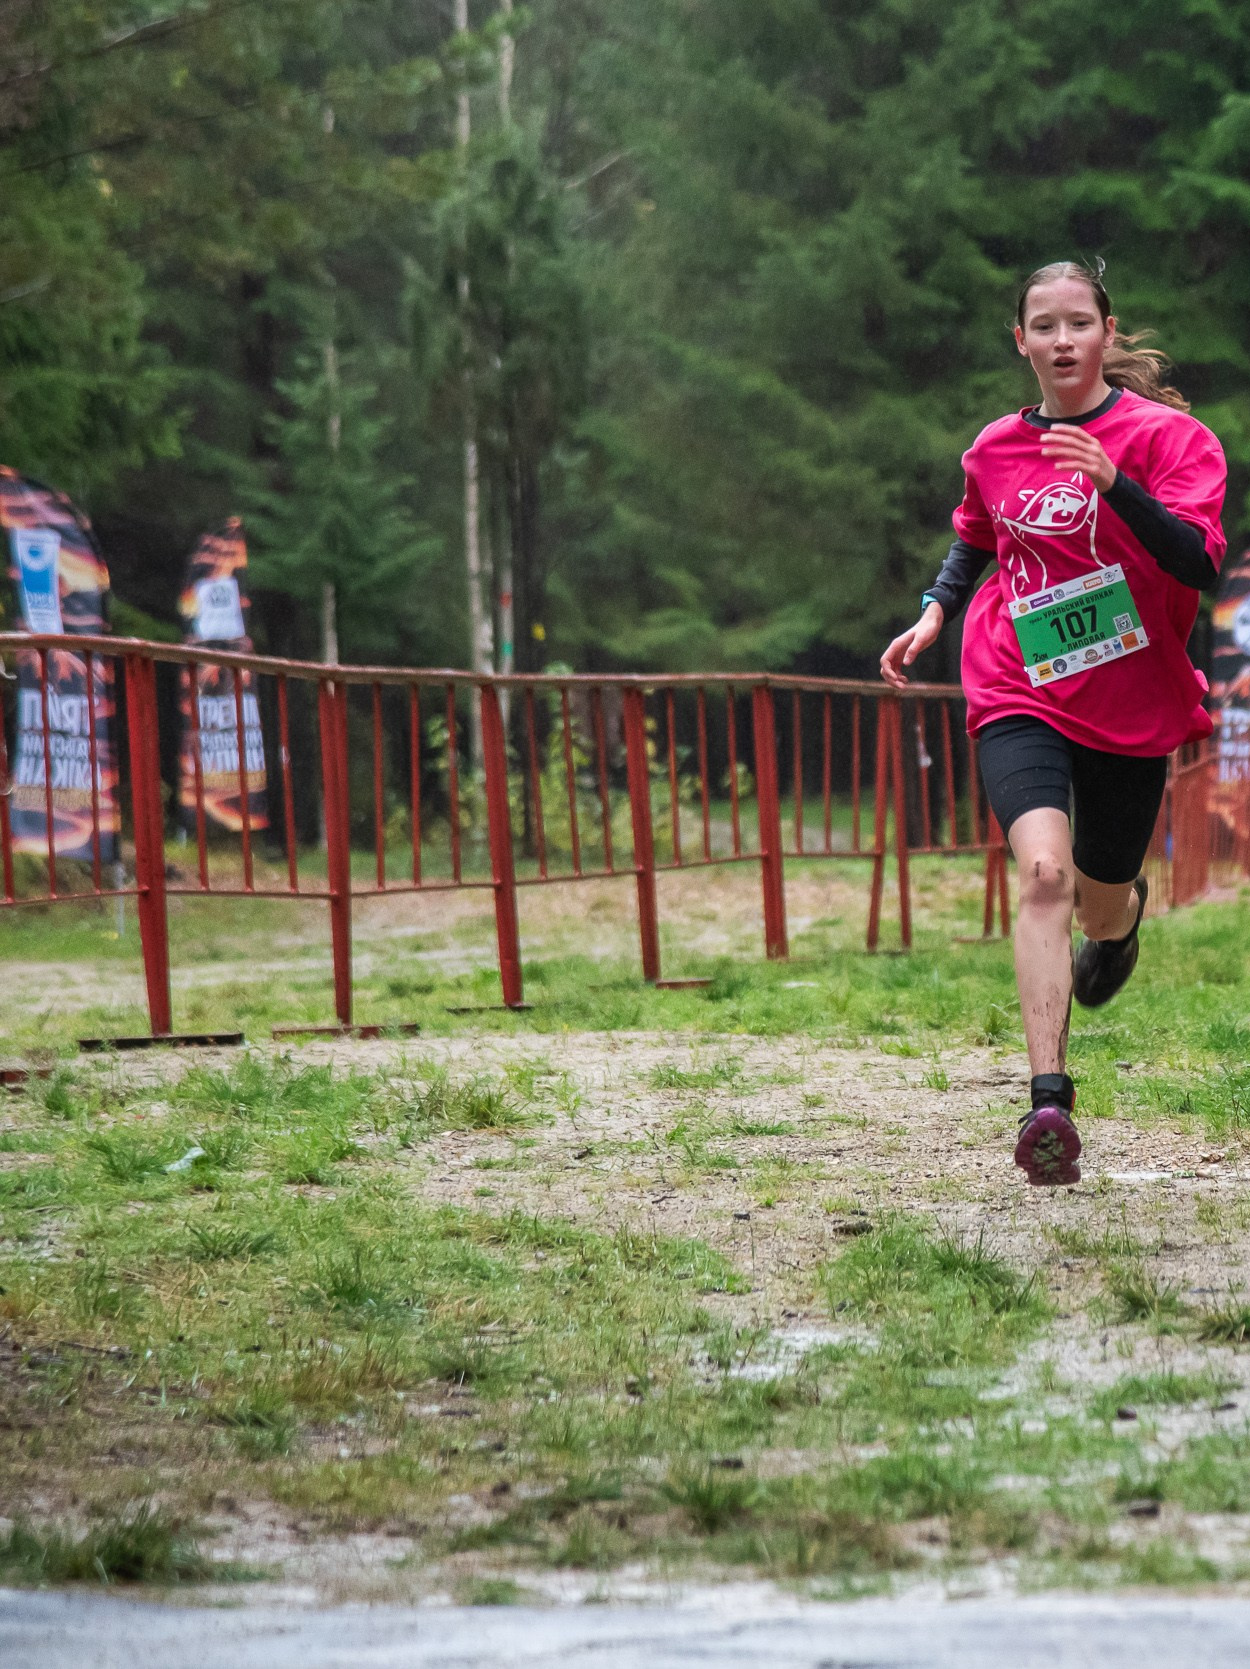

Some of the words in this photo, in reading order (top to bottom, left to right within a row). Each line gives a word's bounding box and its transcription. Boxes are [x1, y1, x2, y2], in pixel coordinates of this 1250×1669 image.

[1043, 599, 1085, 618] УРАЛЬСКИЙ
[1086, 589, 1114, 604] ВУЛКАН
[1050, 605, 1097, 643] 107
[1067, 632, 1106, 651] ЛИПОВАЯ
